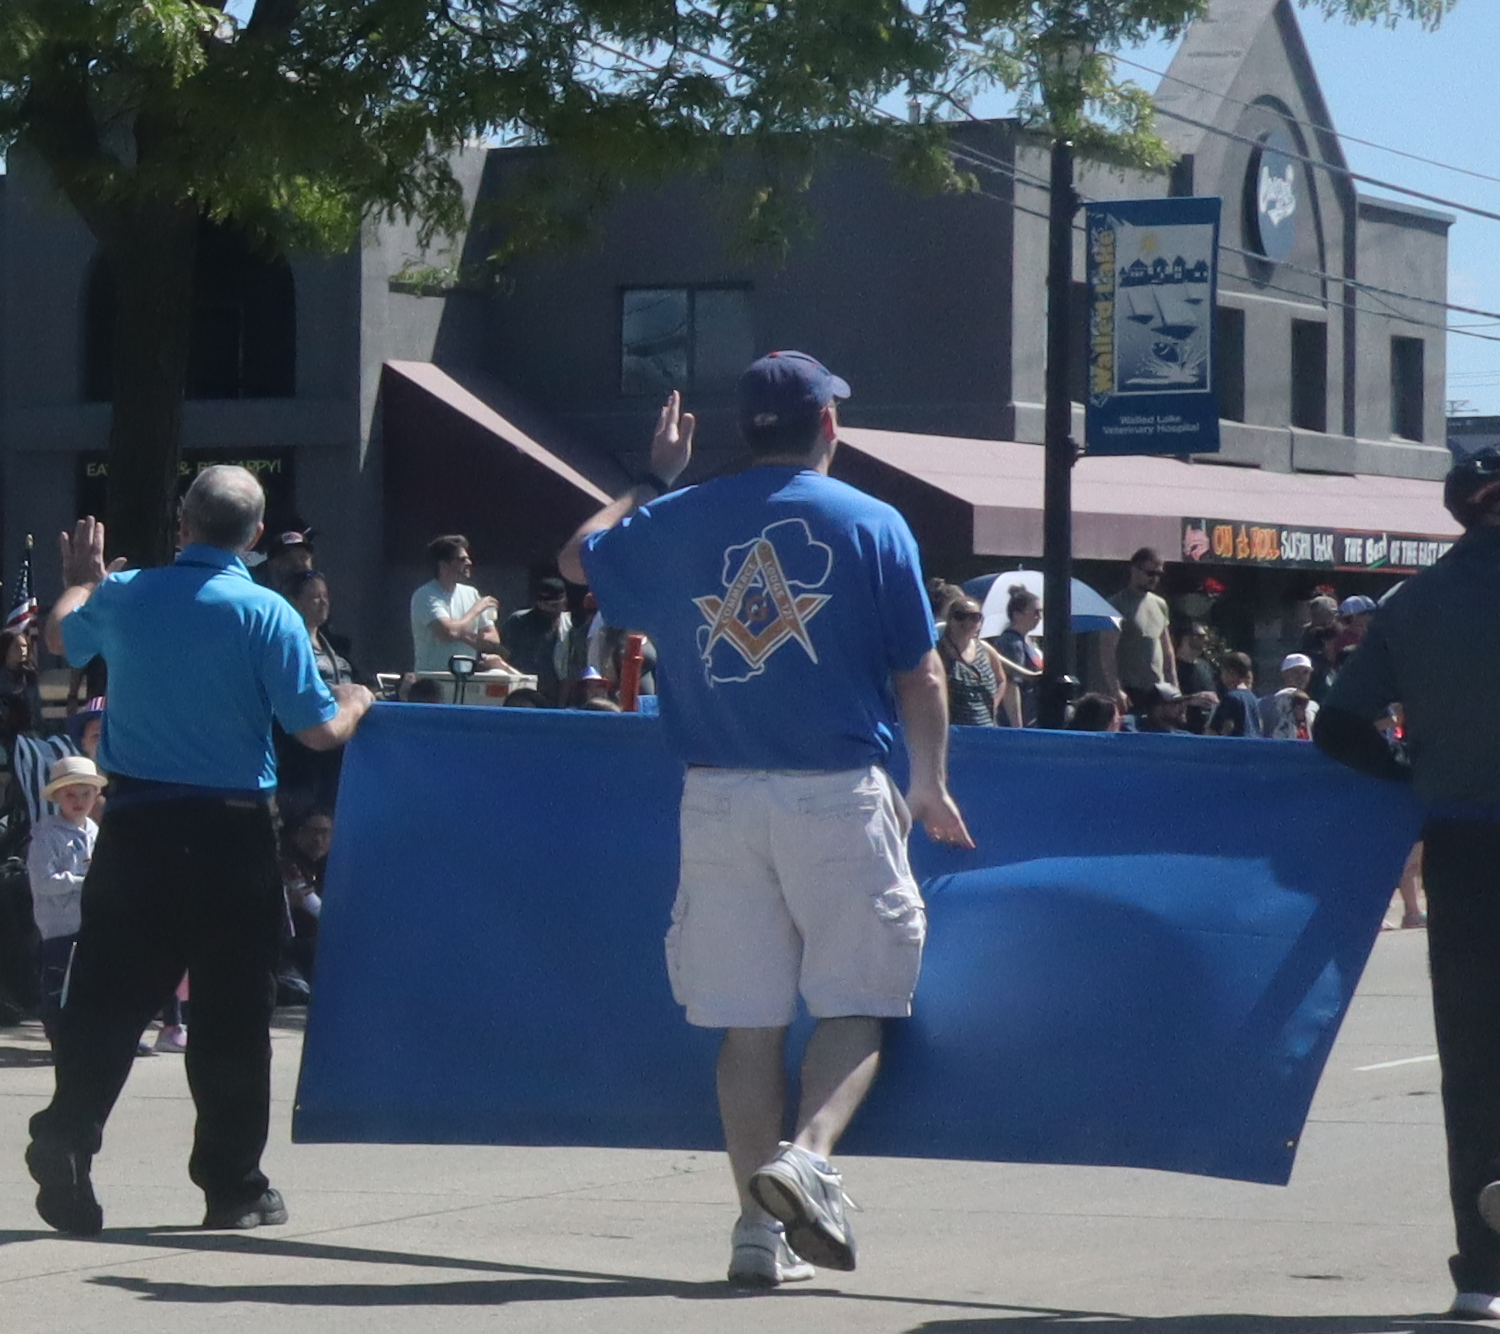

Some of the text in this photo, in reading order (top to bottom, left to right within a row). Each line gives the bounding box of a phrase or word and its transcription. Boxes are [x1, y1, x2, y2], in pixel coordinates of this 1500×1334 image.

[87, 463, 108, 476] EA
[1281, 530, 1311, 561] SUSHI
[1313, 533, 1334, 562] BAR
[1344, 537, 1362, 563] THE
[1390, 541, 1400, 564] OF
[1401, 541, 1418, 565] THE
[721, 561, 757, 624] COMMERCE
[765, 560, 785, 599] LODGE
